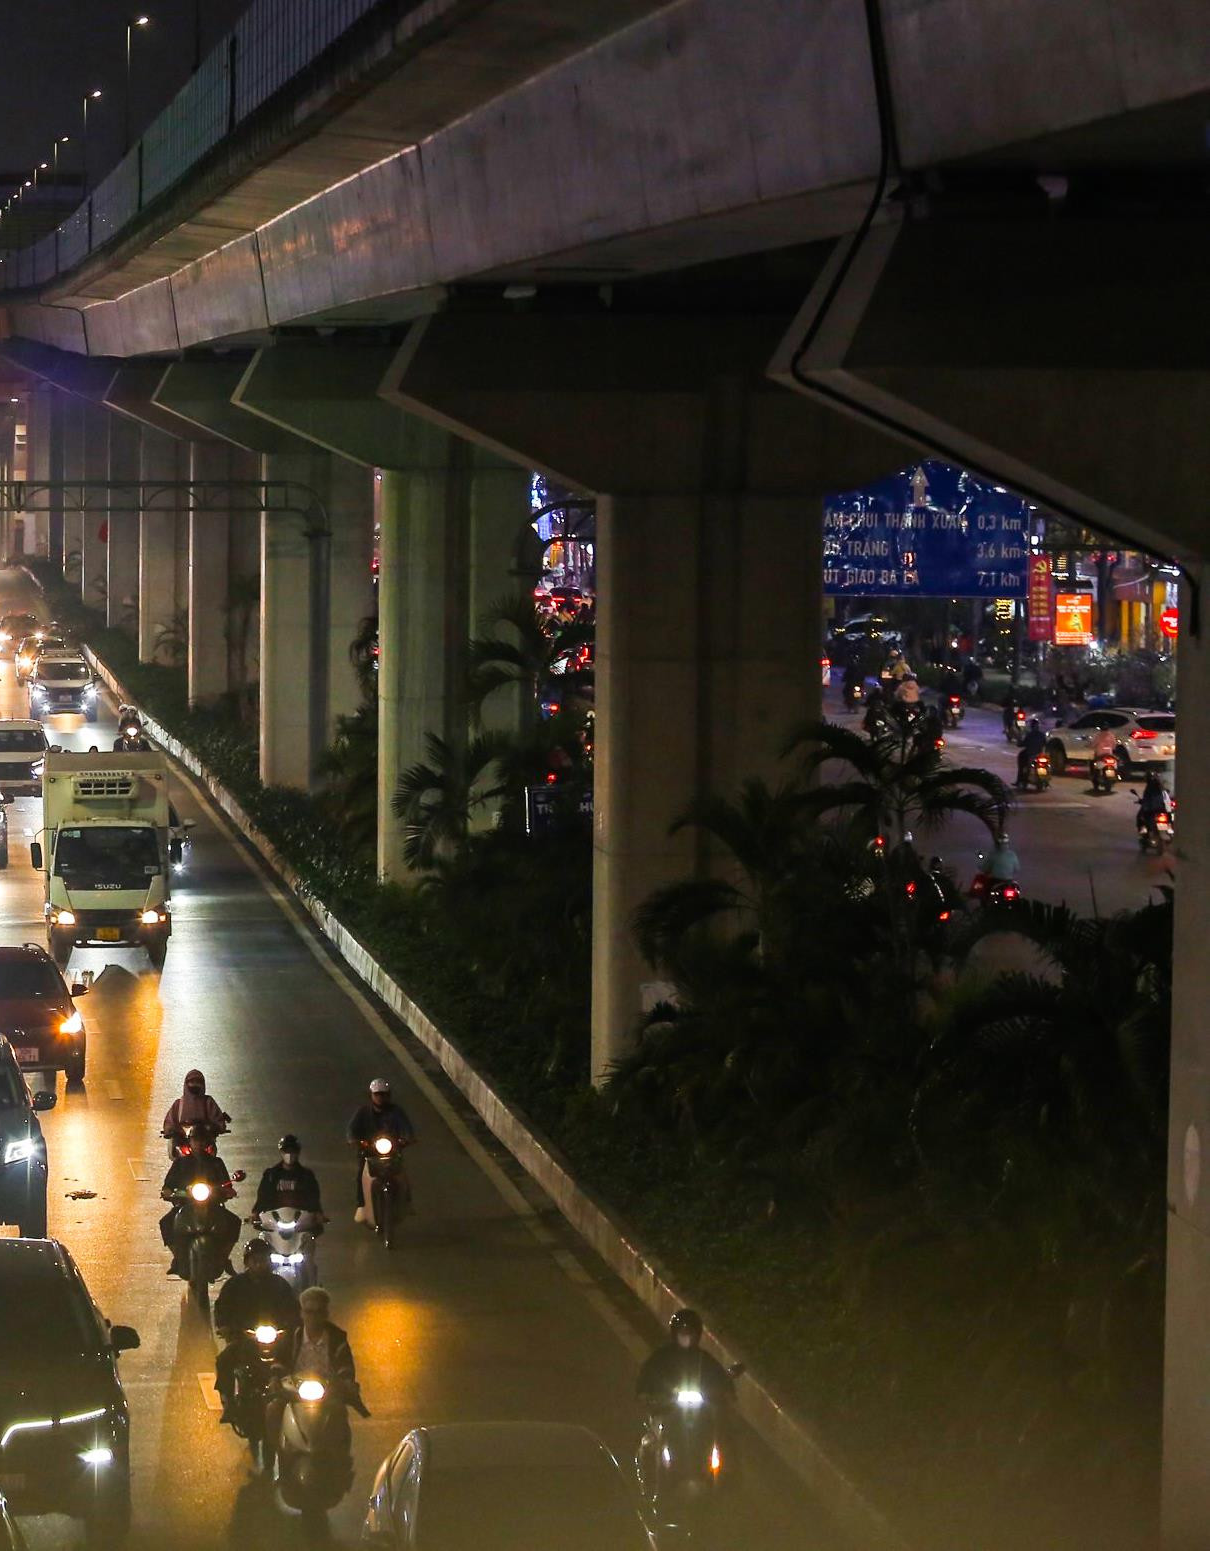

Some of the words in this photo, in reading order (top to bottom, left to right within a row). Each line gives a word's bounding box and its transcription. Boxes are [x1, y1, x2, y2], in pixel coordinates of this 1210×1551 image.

[1001, 516, 1021, 530] km
[1001, 543, 1021, 558] km
[1000, 571, 1020, 586] km
